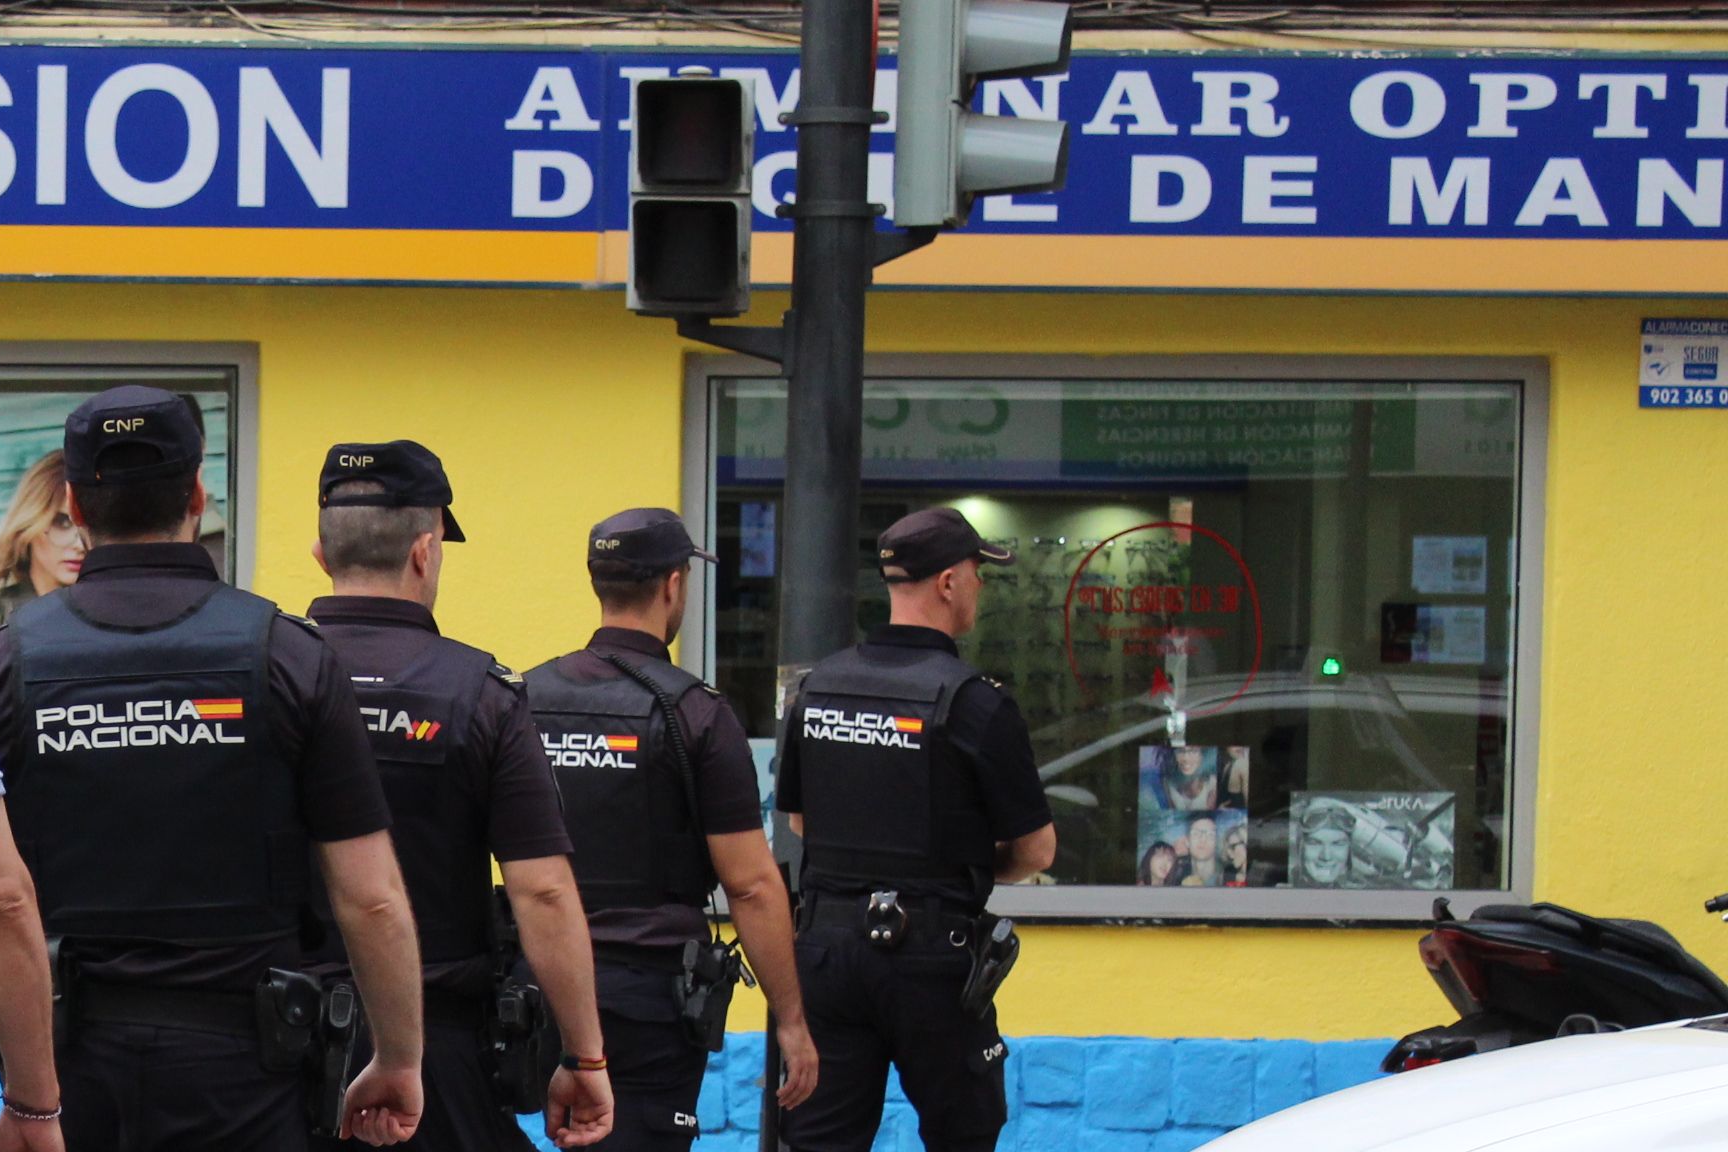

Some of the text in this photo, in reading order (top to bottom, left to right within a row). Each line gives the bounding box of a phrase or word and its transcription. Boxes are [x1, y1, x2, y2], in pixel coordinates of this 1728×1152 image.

[1129, 154, 1319, 225] DE
[1650, 388, 1680, 404] 902
[1685, 388, 1714, 404] 365
[102, 416, 145, 434] CNP
[338, 454, 375, 468] CNP
[594, 539, 621, 551] CNP
[35, 699, 202, 730] POLICIA
[803, 706, 897, 732] POLICIA
[37, 722, 246, 754] NACIONAL
[540, 732, 610, 751] LICIA
[803, 724, 921, 750] NACIONAL
